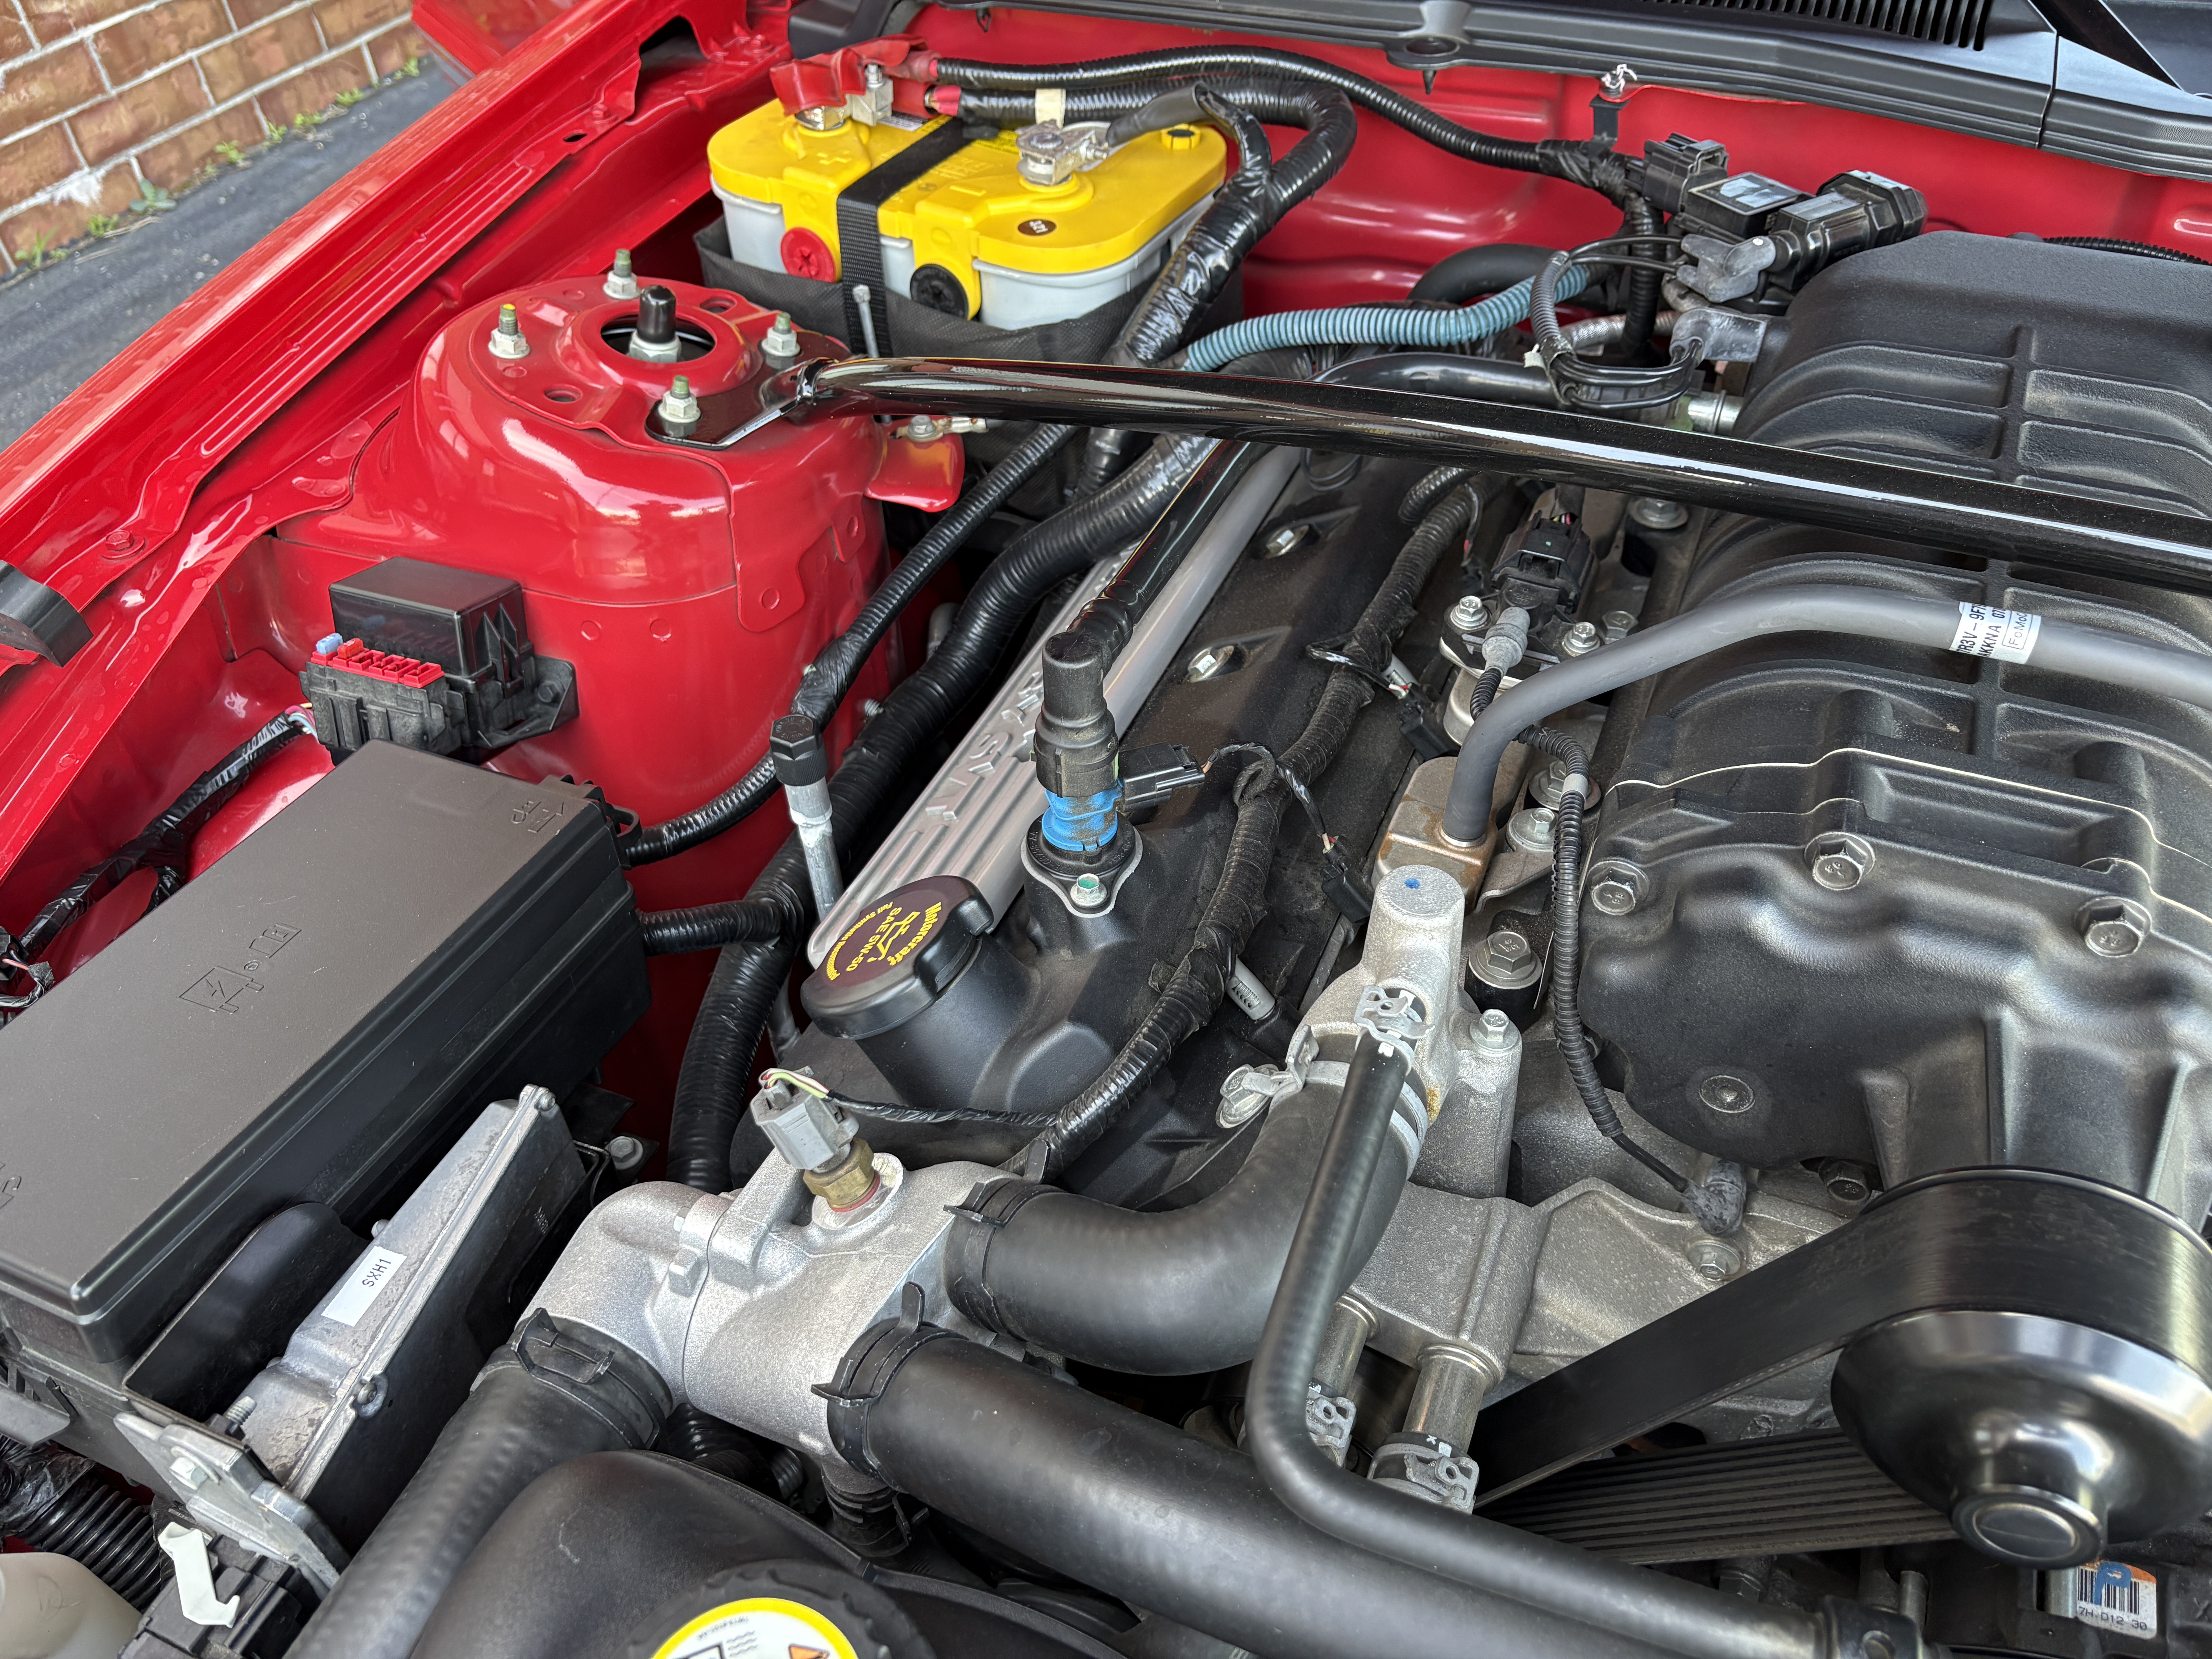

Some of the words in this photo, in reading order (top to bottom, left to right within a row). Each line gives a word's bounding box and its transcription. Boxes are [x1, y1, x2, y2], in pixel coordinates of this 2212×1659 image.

[875, 907, 902, 933] SAE
[877, 901, 893, 914] Full
[841, 911, 876, 941] Synthetic
[887, 902, 941, 966] Motorcraft
[846, 935, 881, 972] 5W-50
[362, 1258, 392, 1288] SXH1
